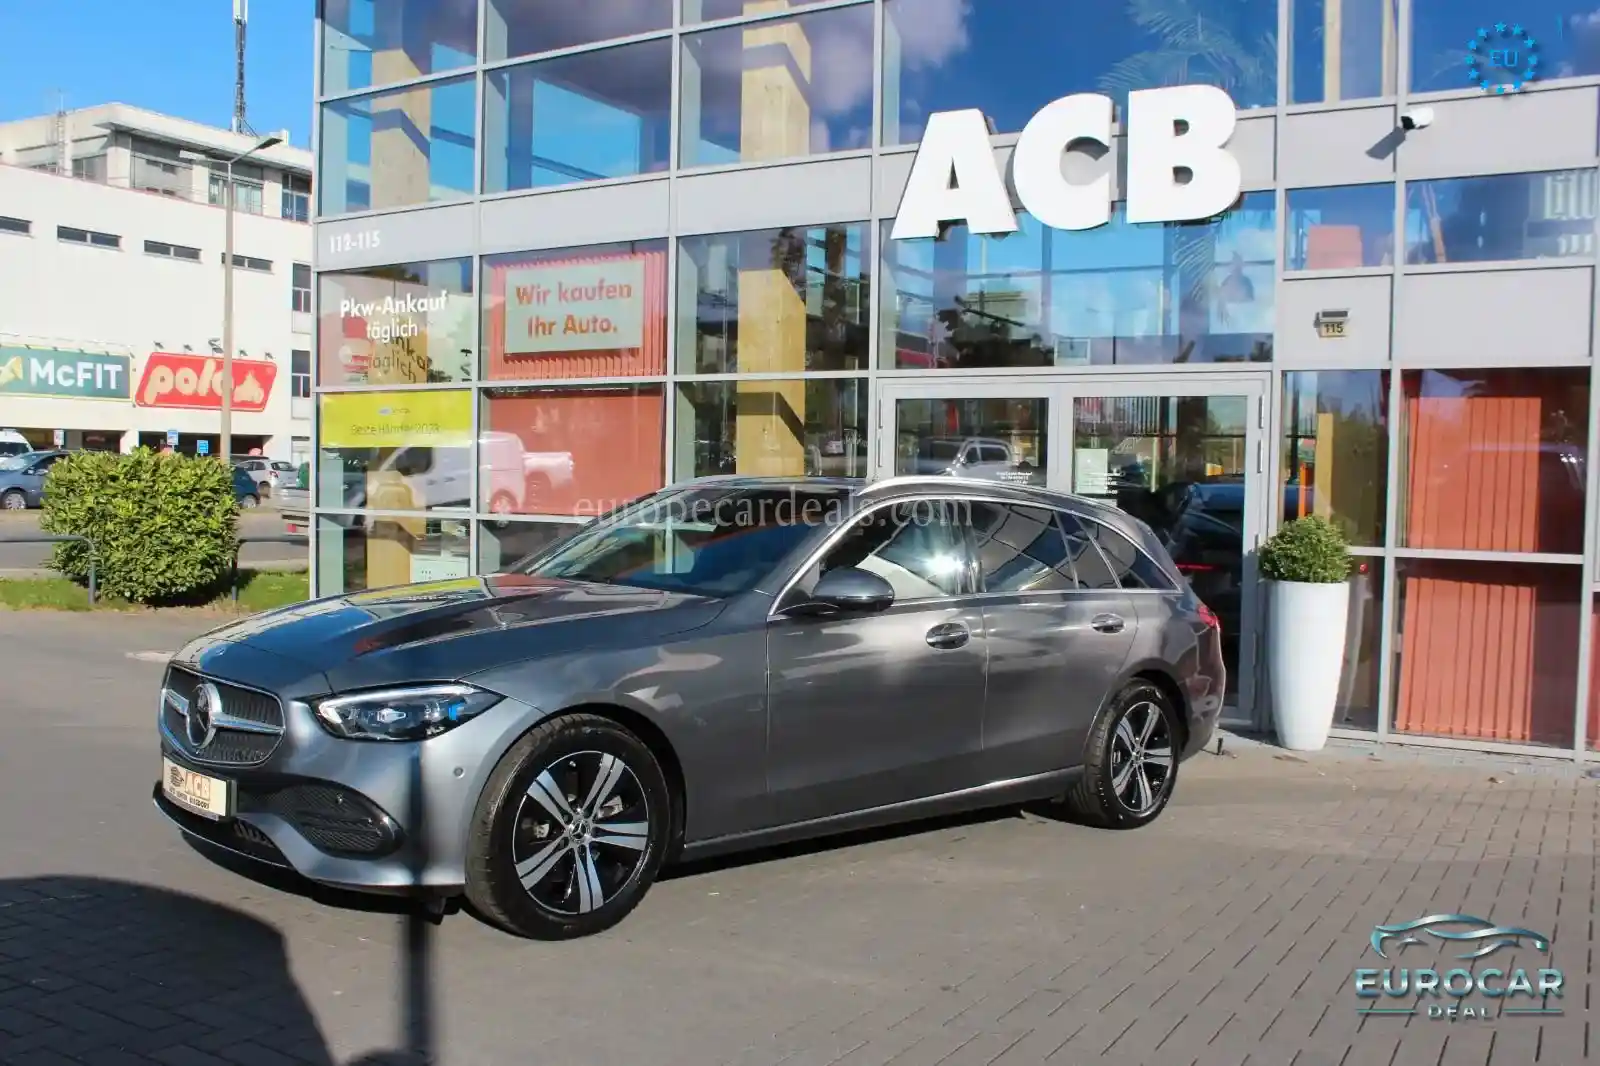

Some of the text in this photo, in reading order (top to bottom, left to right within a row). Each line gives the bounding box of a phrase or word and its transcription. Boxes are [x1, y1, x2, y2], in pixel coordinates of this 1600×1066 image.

[890, 84, 1242, 240] ACB
[330, 230, 381, 254] 112-115
[340, 289, 449, 318] Pkw-Ankauf
[515, 278, 633, 306] Wir kaufen
[366, 314, 418, 343] täglich
[527, 313, 618, 339] Ihr Auto.
[1323, 323, 1344, 334] 115
[29, 357, 123, 390] McFIT
